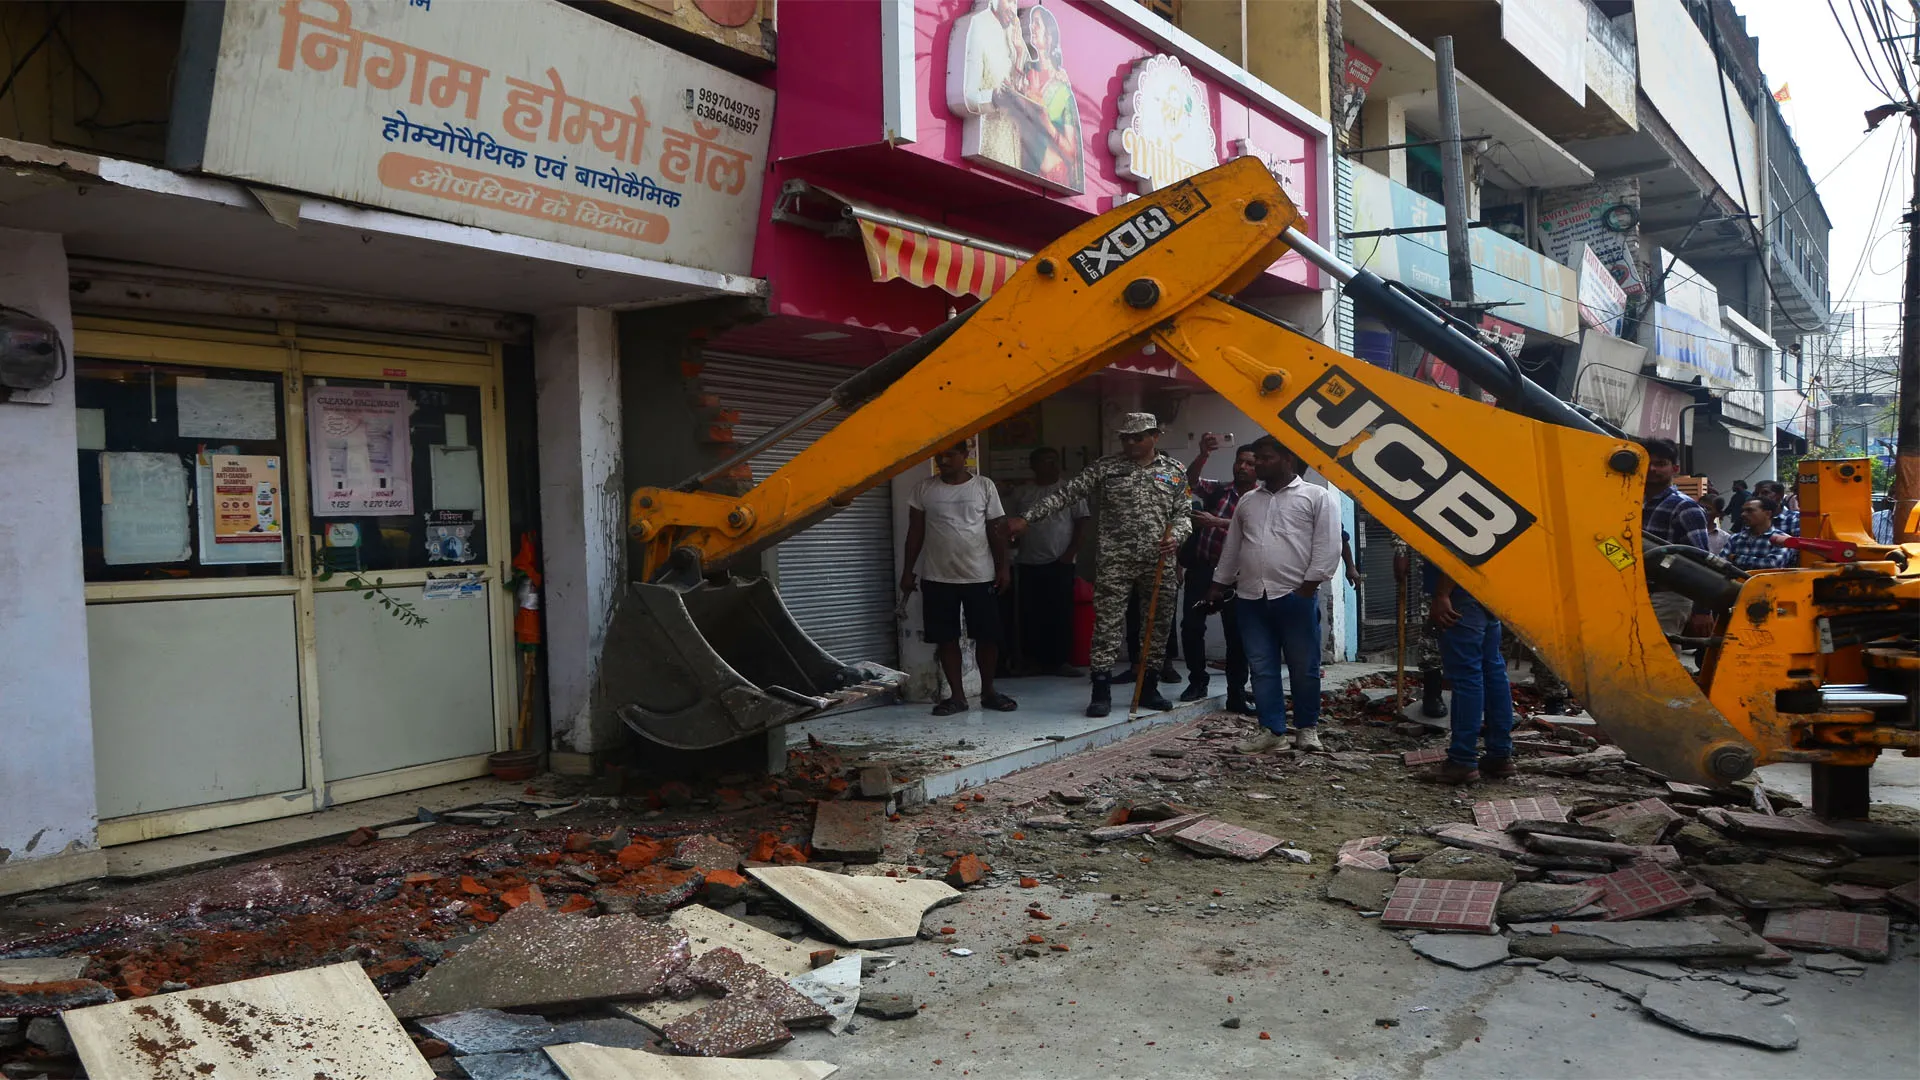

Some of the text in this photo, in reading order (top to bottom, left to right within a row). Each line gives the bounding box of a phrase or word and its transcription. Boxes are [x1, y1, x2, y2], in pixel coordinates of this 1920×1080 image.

[278, 0, 752, 196] निगम होम्यो हॉल
[697, 104, 758, 135] 6396455997
[699, 87, 760, 121] 9897049795
[382, 110, 682, 209] होम्योपैथिक एवं बायोकैमिक
[409, 165, 650, 236] औषधियों के विक्रेता
[1557, 211, 1591, 227] STUDIO
[1075, 253, 1099, 280] PLUS
[1295, 396, 1517, 556] JCB
